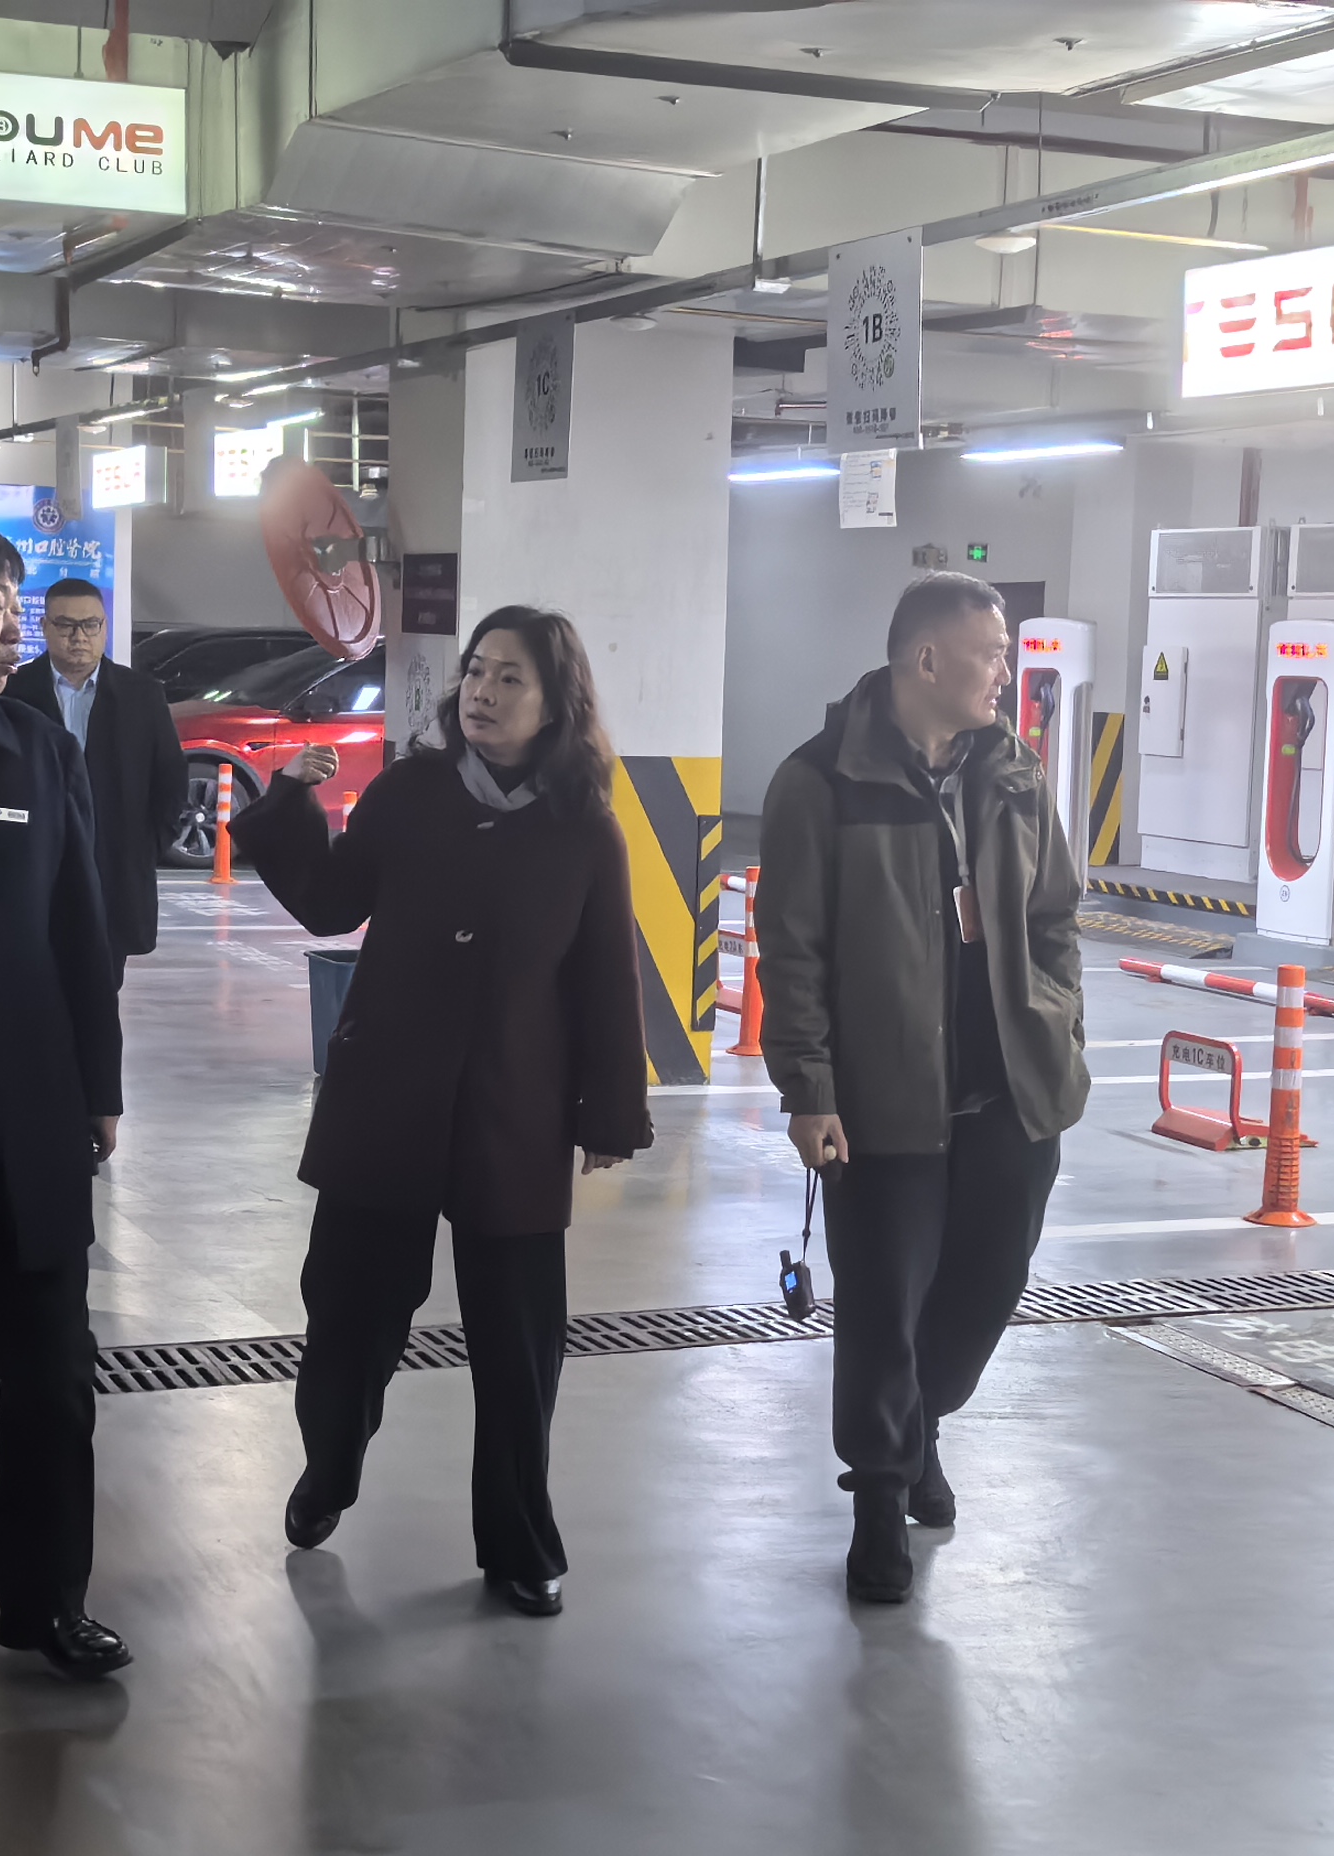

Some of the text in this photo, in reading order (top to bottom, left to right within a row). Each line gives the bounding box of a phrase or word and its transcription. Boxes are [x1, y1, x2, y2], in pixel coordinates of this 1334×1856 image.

[98, 156, 163, 176] CLUB
[862, 313, 883, 344] 1B
[536, 372, 550, 397] 1C
